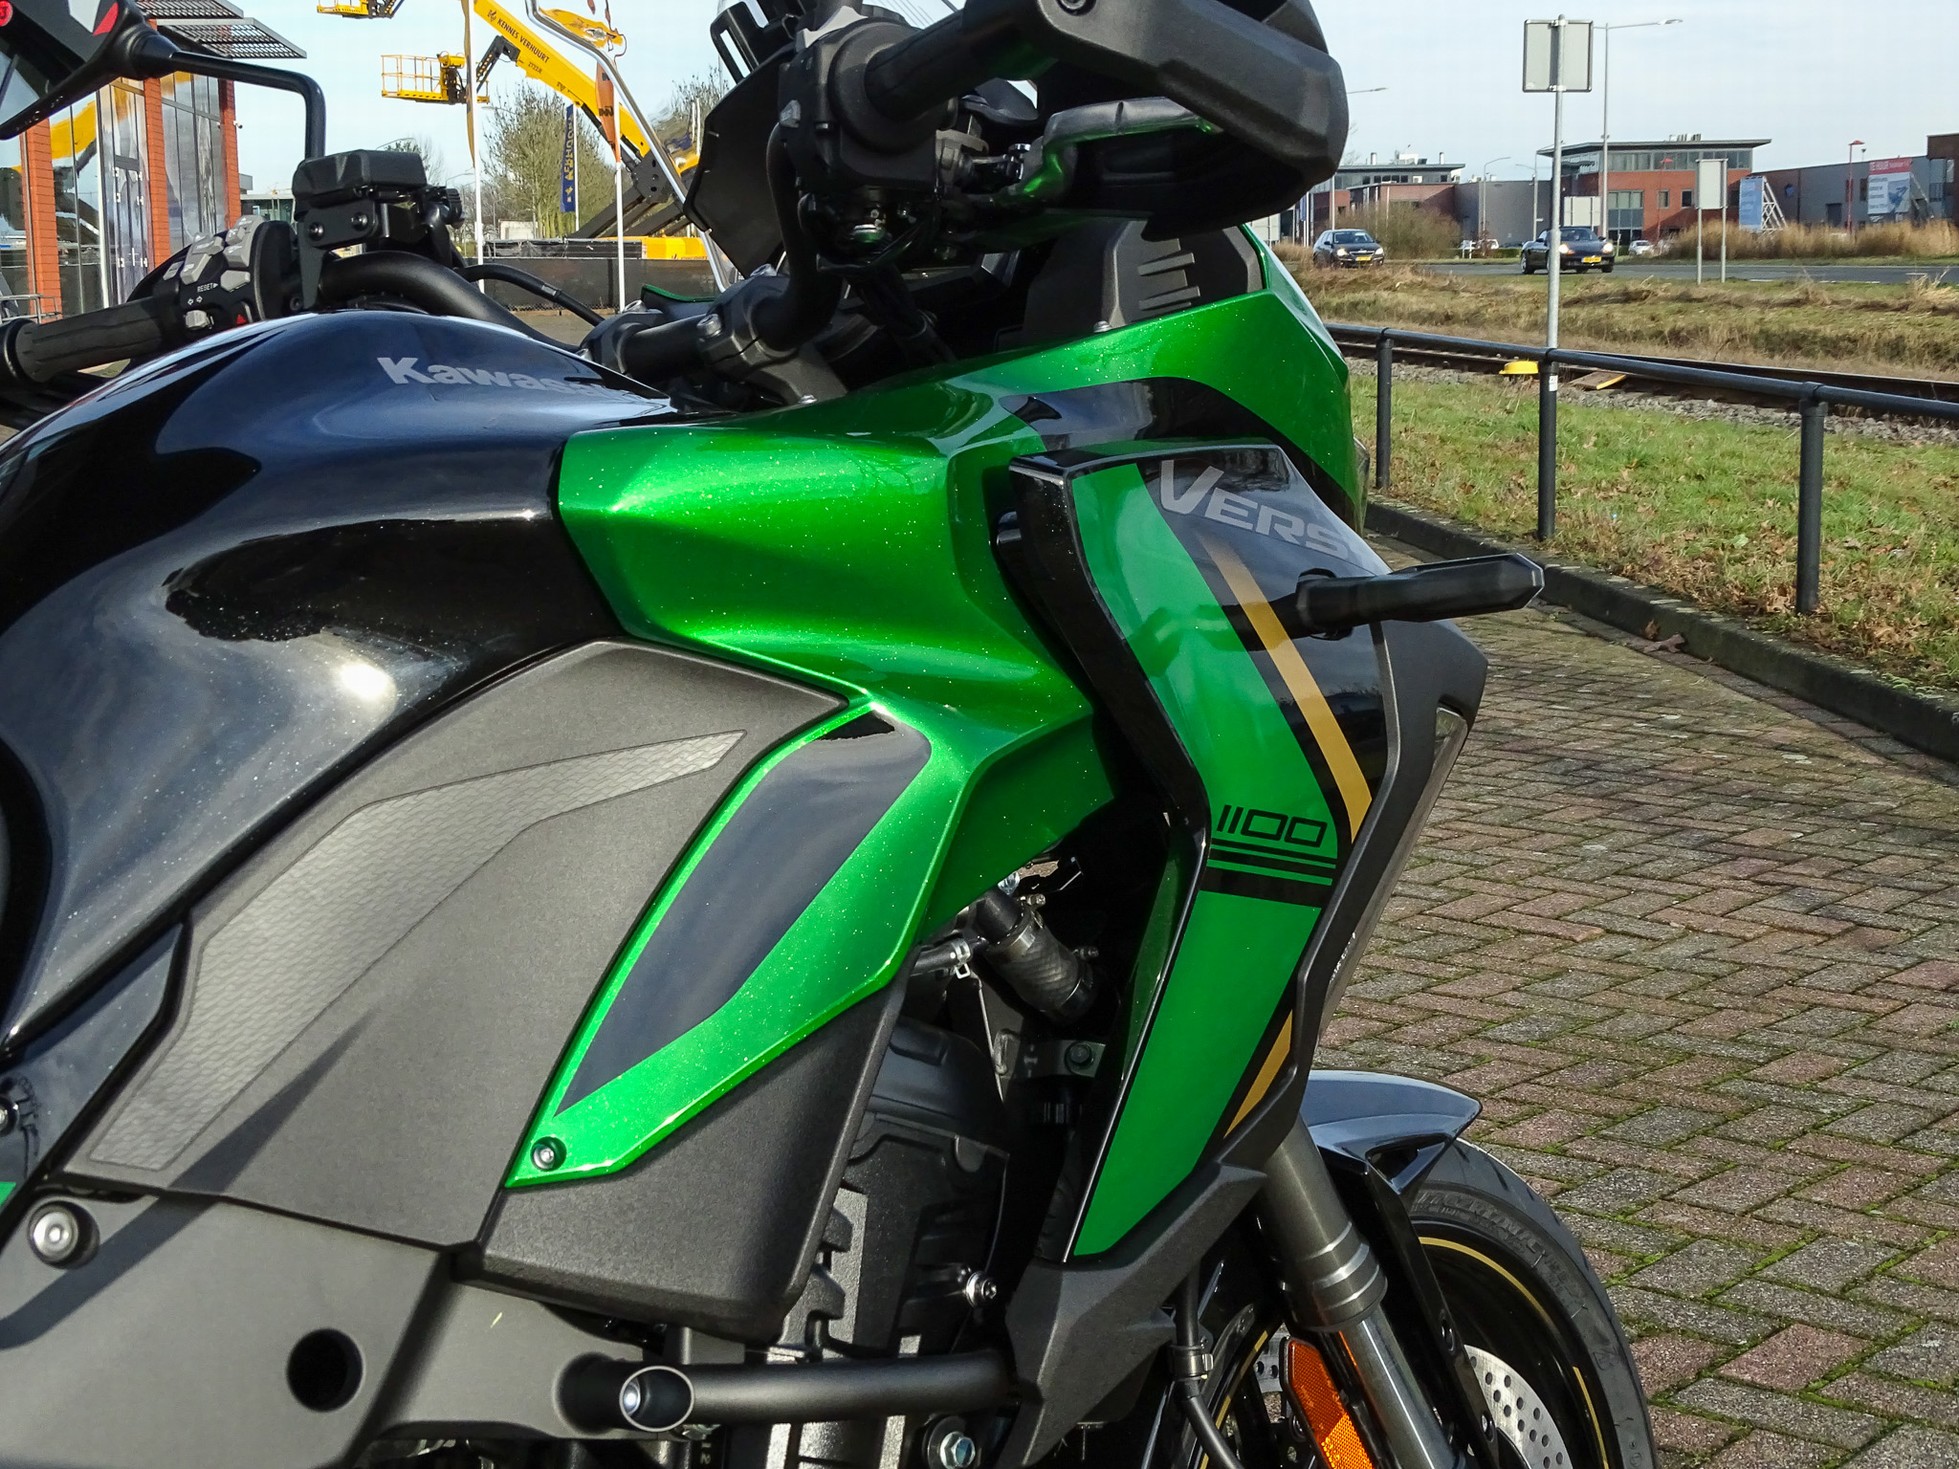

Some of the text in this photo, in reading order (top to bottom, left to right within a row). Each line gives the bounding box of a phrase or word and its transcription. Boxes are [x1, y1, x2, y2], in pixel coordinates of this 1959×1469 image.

[497, 18, 520, 39] KENNES
[197, 282, 214, 292] RESET
[1216, 804, 1328, 848] 1100
